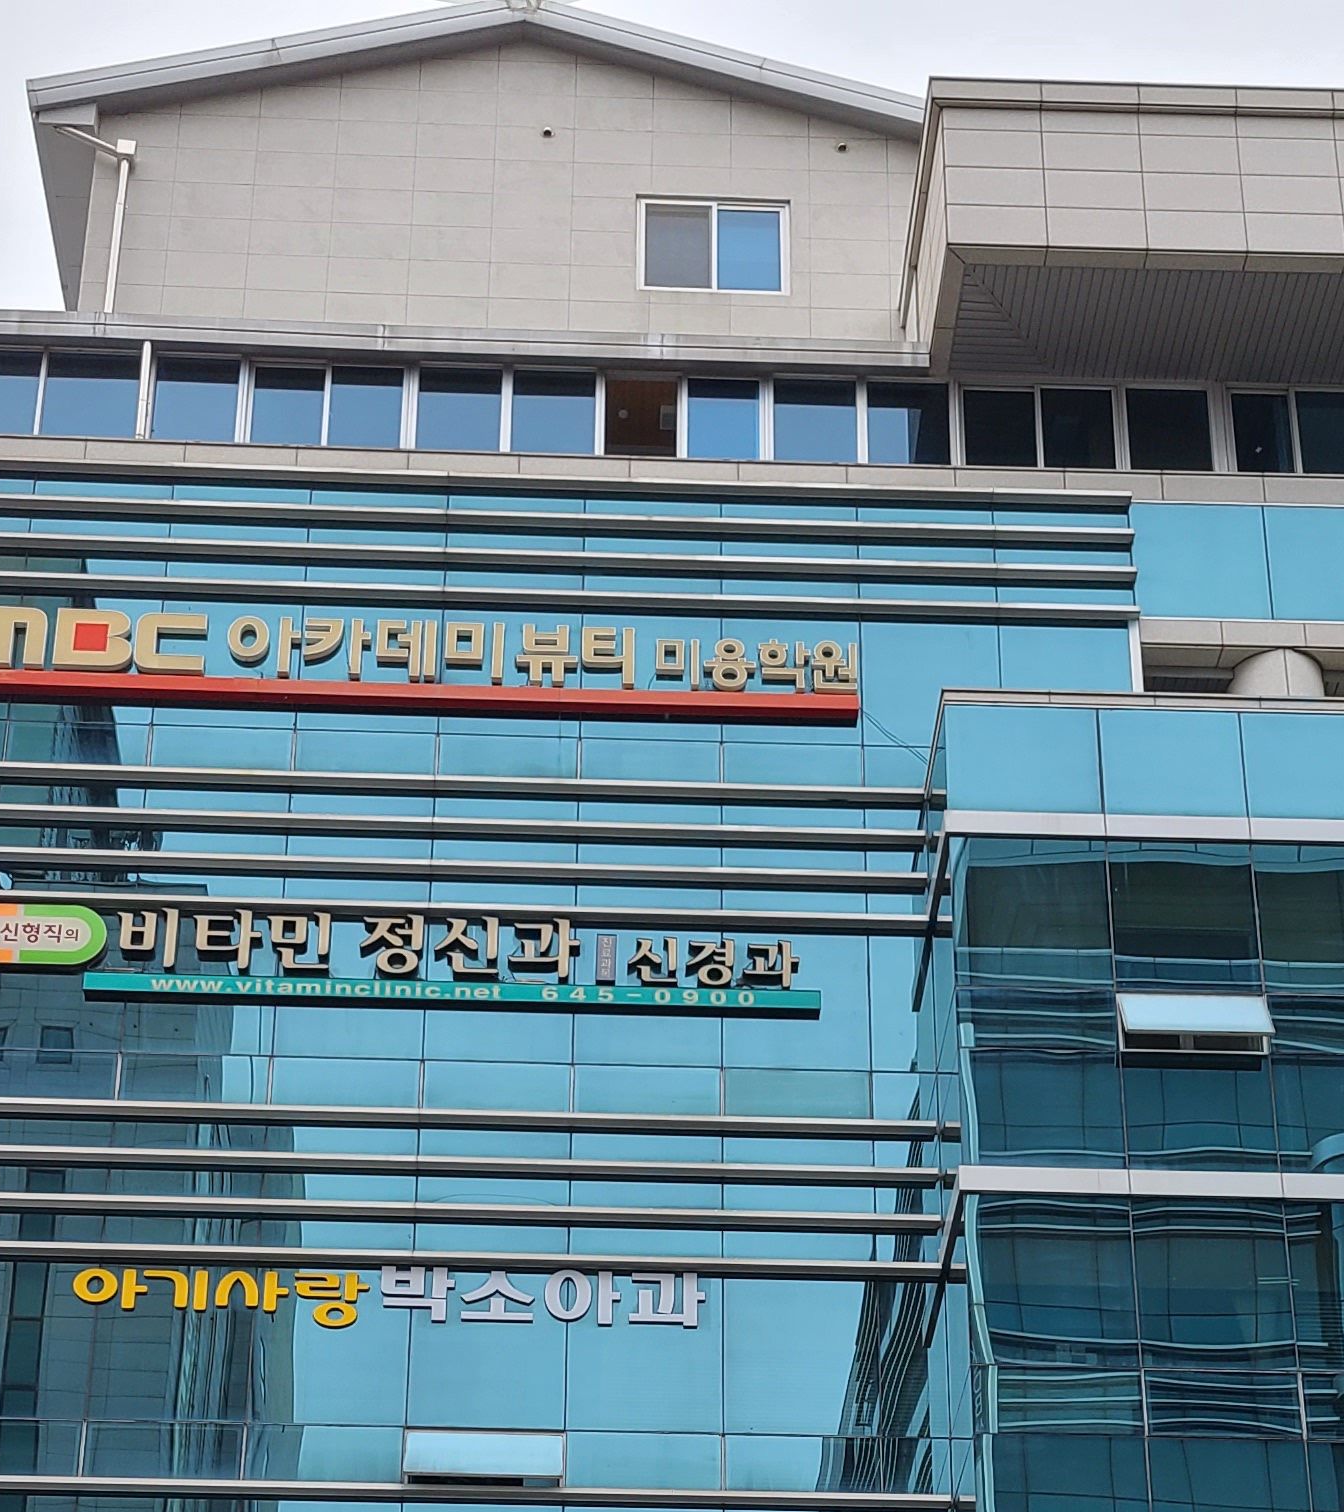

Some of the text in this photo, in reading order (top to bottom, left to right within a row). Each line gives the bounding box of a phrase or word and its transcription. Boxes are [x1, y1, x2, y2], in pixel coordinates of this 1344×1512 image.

[227, 615, 635, 692] 아카데미뷰티
[654, 637, 859, 697] 미용학원
[0, 921, 80, 944] 신형직의
[117, 907, 801, 990] 비타민 정신과 신경과
[150, 976, 756, 1008] www.vitaminclinic.net 645-0900
